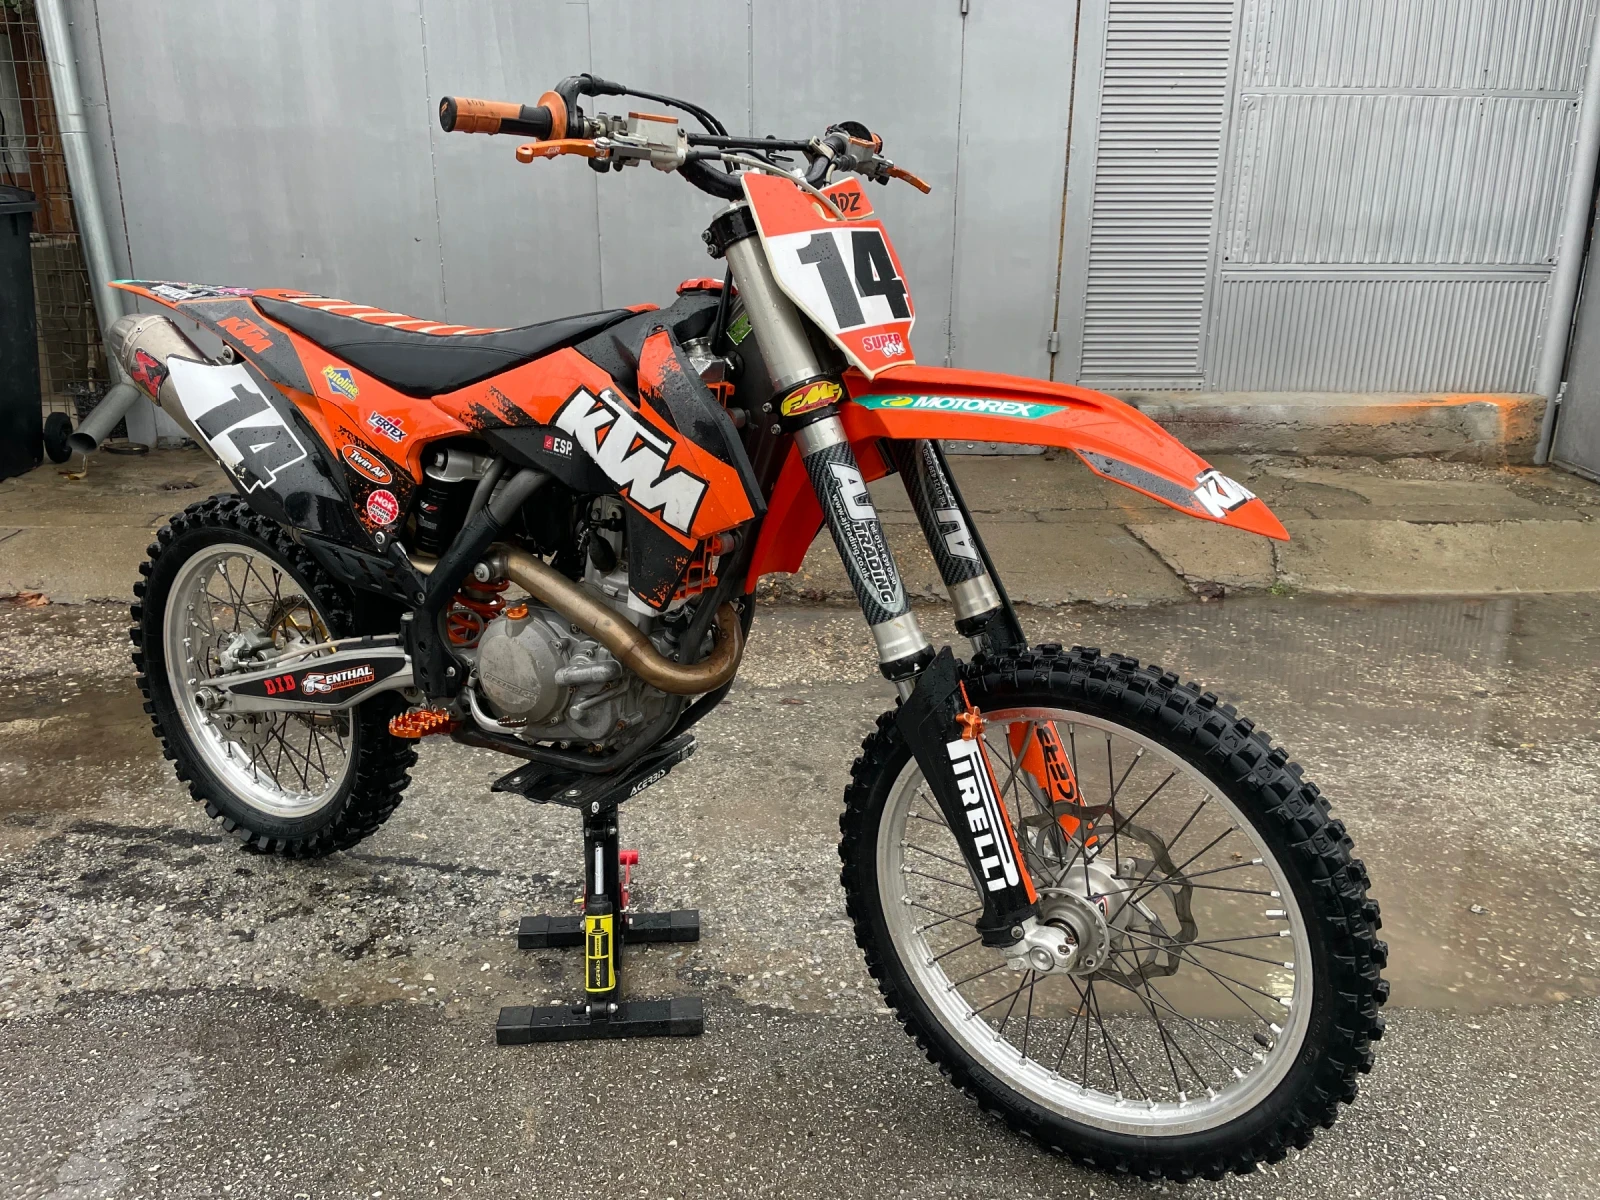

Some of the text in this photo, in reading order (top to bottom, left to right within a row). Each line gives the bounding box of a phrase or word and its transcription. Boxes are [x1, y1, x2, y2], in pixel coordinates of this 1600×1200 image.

[796, 231, 912, 329] 14
[216, 316, 274, 354] KTM
[862, 333, 902, 351] SUPER
[322, 365, 360, 396] Putoline
[783, 383, 840, 416] FMF
[913, 396, 1036, 418] MOTOREX
[195, 383, 308, 493] 14
[370, 411, 407, 441] VERTEX
[350, 449, 387, 479] Twin Air
[555, 388, 706, 534] KTM
[371, 503, 390, 518] SPARK
[374, 495, 395, 512] NGK
[832, 493, 871, 581] www.ajtrading.co.uk
[852, 520, 896, 604] TRADING
[947, 739, 1019, 892] PIRELLI
